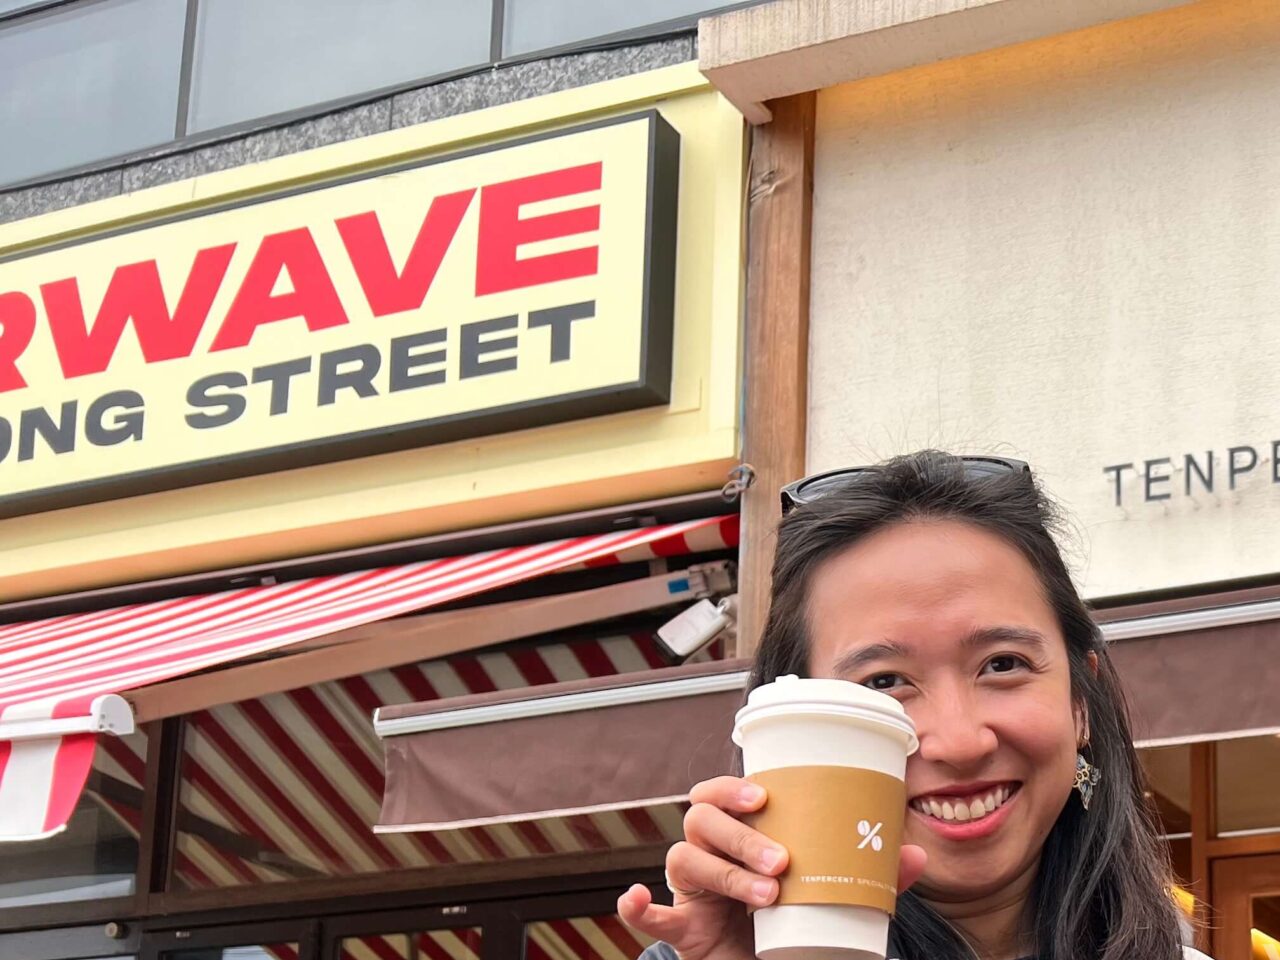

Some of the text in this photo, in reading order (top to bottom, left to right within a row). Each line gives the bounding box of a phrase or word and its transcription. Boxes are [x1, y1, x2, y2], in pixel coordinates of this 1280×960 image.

[0, 300, 596, 464] NG STREET
[801, 875, 854, 884] TENPERCENT
